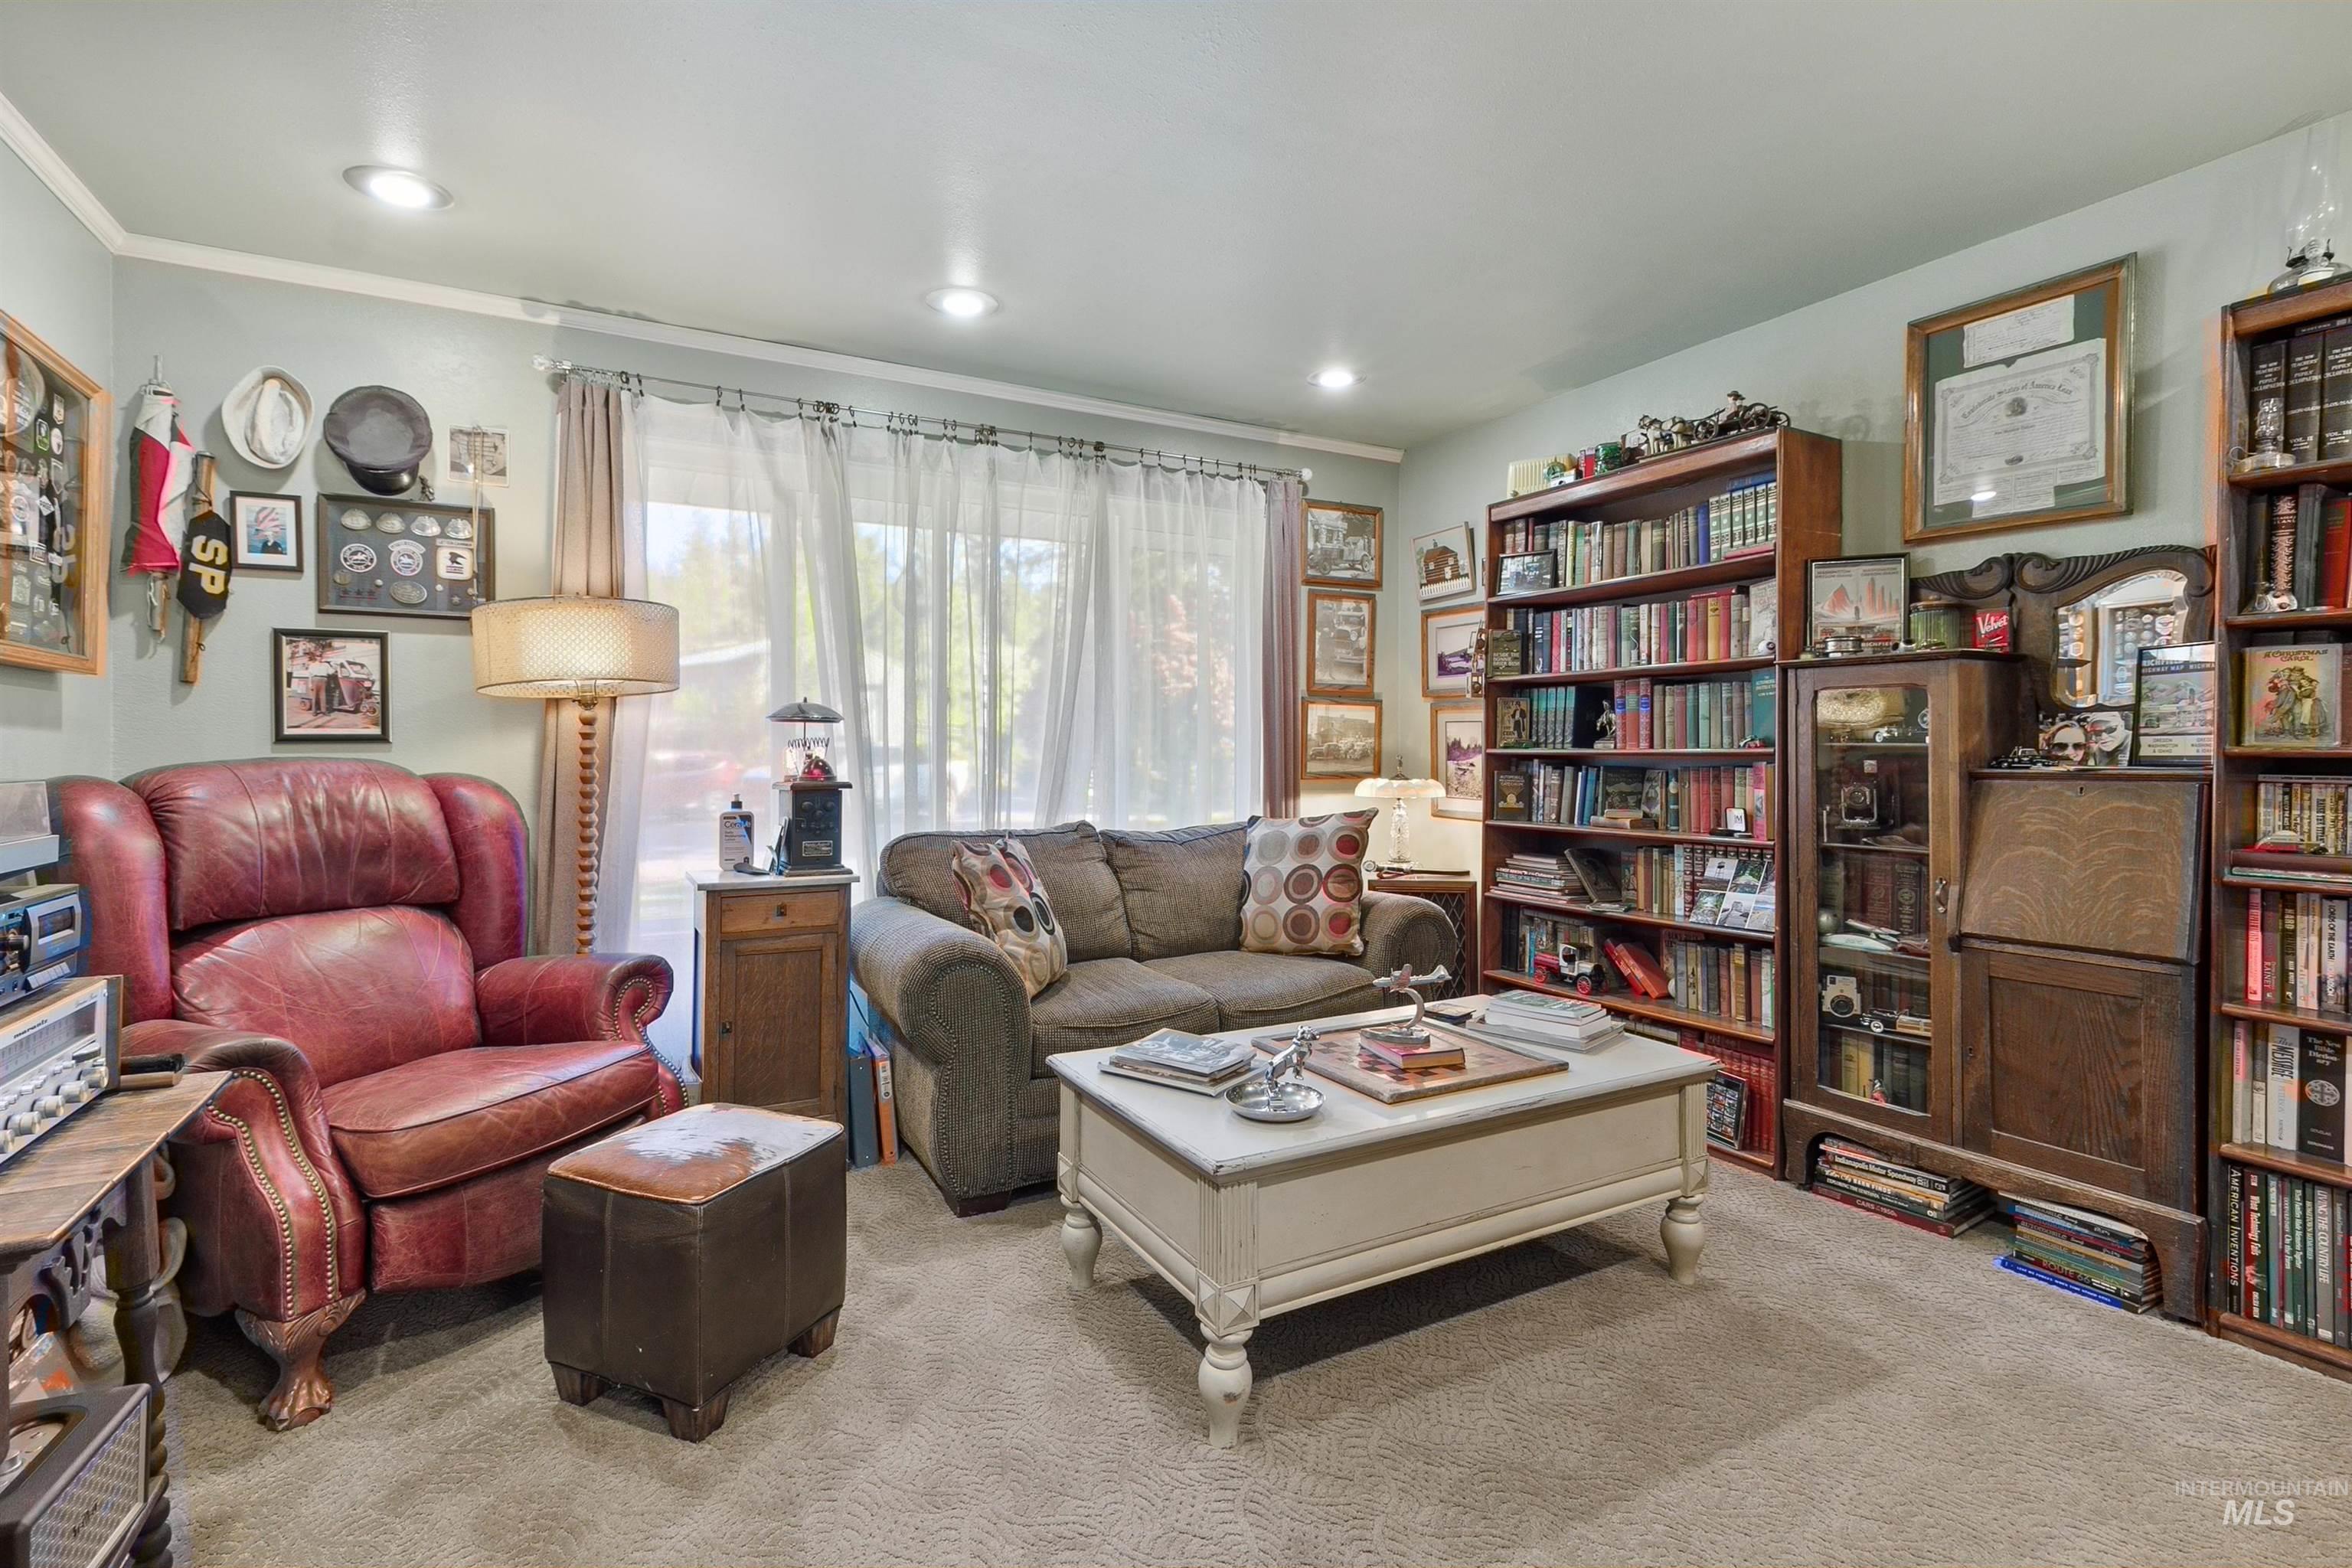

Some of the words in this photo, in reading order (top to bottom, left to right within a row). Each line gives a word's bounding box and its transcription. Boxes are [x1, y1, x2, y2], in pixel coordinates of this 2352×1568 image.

[1976, 610, 2009, 635] Velvet
[2272, 649, 2328, 658] CHRISTMAS
[2285, 909, 2295, 929] HARD
[2328, 905, 2336, 923] LORDS
[2328, 923, 2336, 932] OF
[2328, 942, 2336, 960] EARTH
[2307, 1036, 2323, 1045] The
[2324, 1039, 2341, 1048] New
[2314, 1044, 2335, 1054] Bible
[2271, 1044, 2295, 1079] MESSAGE
[1834, 1155, 1868, 1171] Indianapolis
[1868, 1164, 1886, 1175] Motor
[1886, 1169, 1917, 1184] Speedway
[1870, 1184, 1892, 1194] FINDS
[2230, 1168, 2242, 1223] AMERICAN
[1856, 1199, 1875, 1210] CARS
[2249, 1195, 2260, 1210] When
[2317, 1190, 2329, 1214] LIVING
[2248, 1211, 2261, 1240] Technology
[2318, 1216, 2329, 1231] THE
[2230, 1225, 2242, 1286] INVENTIONS
[2250, 1242, 2262, 1256] Fails
[2318, 1231, 2330, 1269] COUNTRY
[2285, 1254, 2293, 1269] Farm
[2042, 1259, 2076, 1278] ROUTE
[2077, 1273, 2092, 1284] 66
[2319, 1269, 2331, 1285] LIFE
